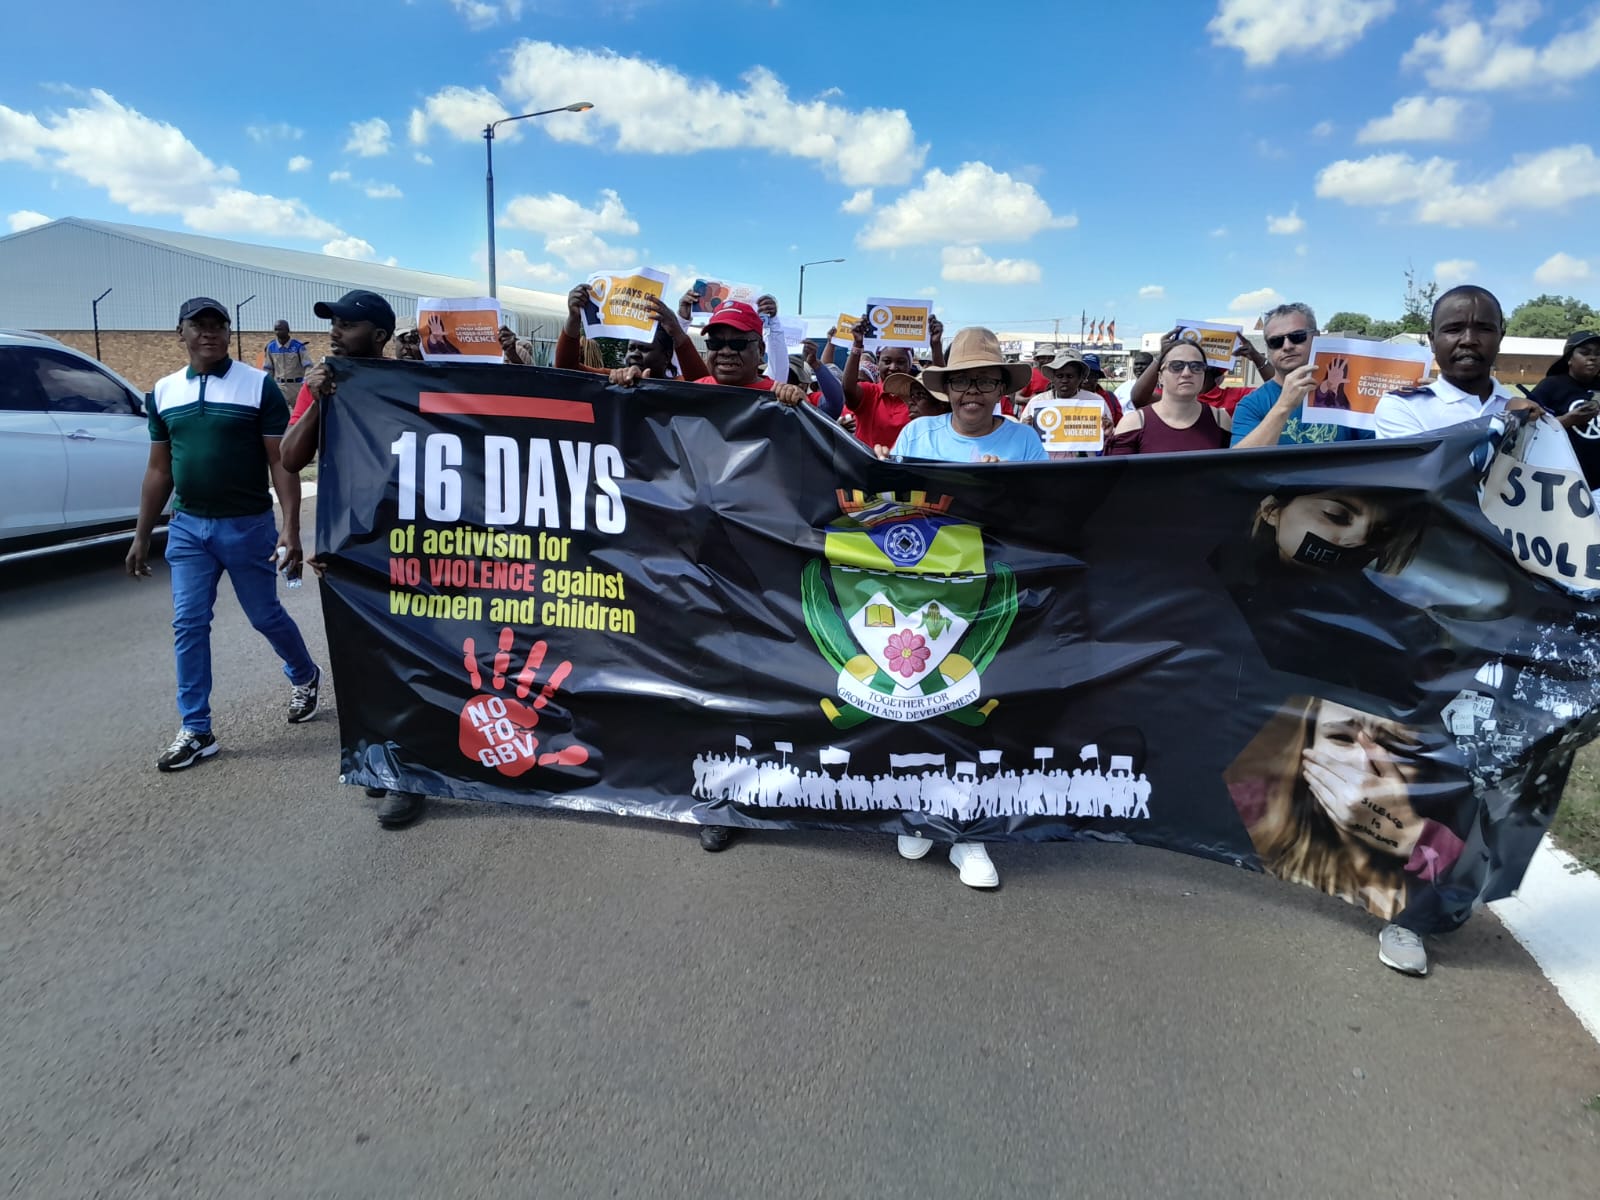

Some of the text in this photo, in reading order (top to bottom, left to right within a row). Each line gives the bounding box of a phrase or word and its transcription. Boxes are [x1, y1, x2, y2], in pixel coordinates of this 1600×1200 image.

[609, 306, 650, 322] VIOLENCE
[894, 328, 923, 336] VIOLENCE
[391, 431, 627, 535] 16 DAYS
[389, 524, 571, 562] of activism for
[389, 557, 626, 600] NO VIOLENCE against
[389, 590, 636, 634] women and children
[467, 696, 508, 728] NO
[838, 687, 980, 720] GROWTH AND DEVELOPMENT
[869, 691, 950, 708] TOGETHER FOR
[478, 717, 515, 746] TO
[478, 733, 534, 768] GBV
